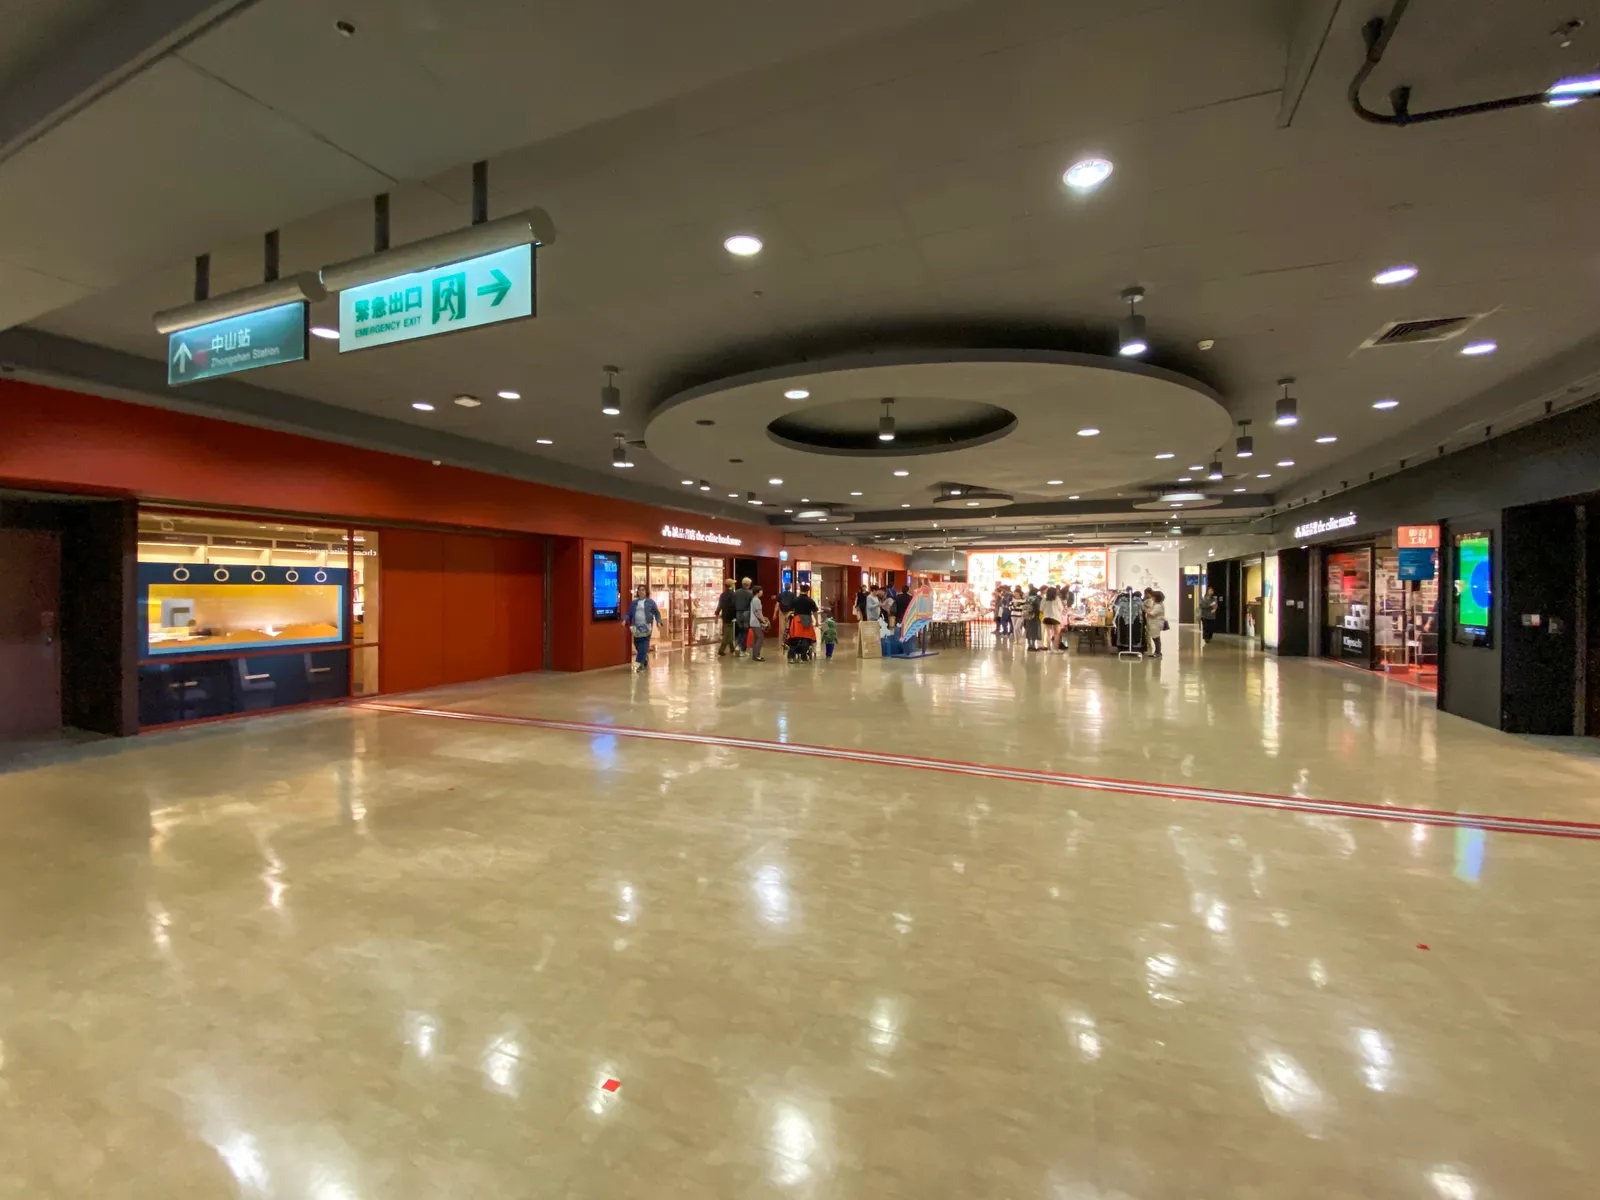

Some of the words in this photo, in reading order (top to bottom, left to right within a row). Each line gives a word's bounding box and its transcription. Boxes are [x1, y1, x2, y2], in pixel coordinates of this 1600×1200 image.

[355, 286, 422, 323] 緊急出口
[355, 321, 400, 338] EMERGENCY
[403, 315, 422, 328] EXIT
[211, 328, 251, 353] 中山站
[211, 352, 251, 368] Zhongshan
[252, 346, 280, 359] Station
[1338, 511, 1357, 528] music
[696, 530, 705, 541] the
